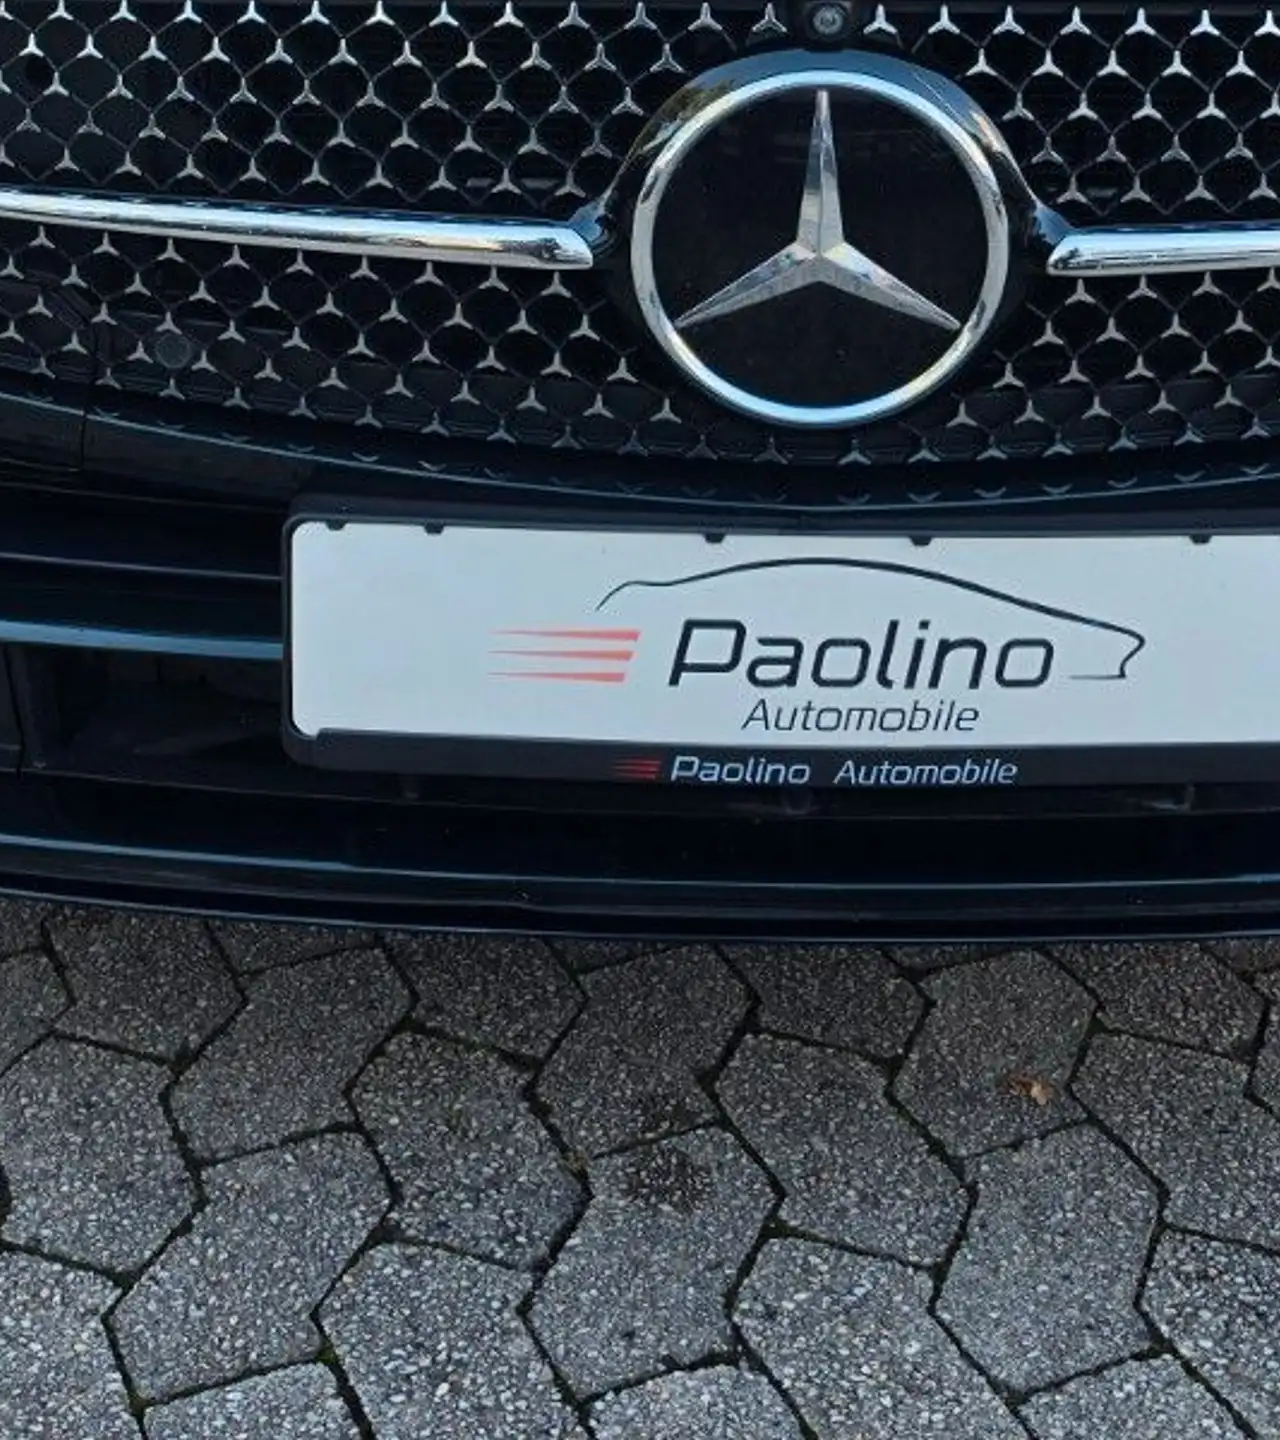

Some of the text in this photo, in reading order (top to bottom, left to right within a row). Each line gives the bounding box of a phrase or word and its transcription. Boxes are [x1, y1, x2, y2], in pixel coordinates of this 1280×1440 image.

[668, 618, 1055, 690] Paolino
[741, 698, 980, 732] Automobile
[670, 755, 1018, 786] Paolino Automobile
